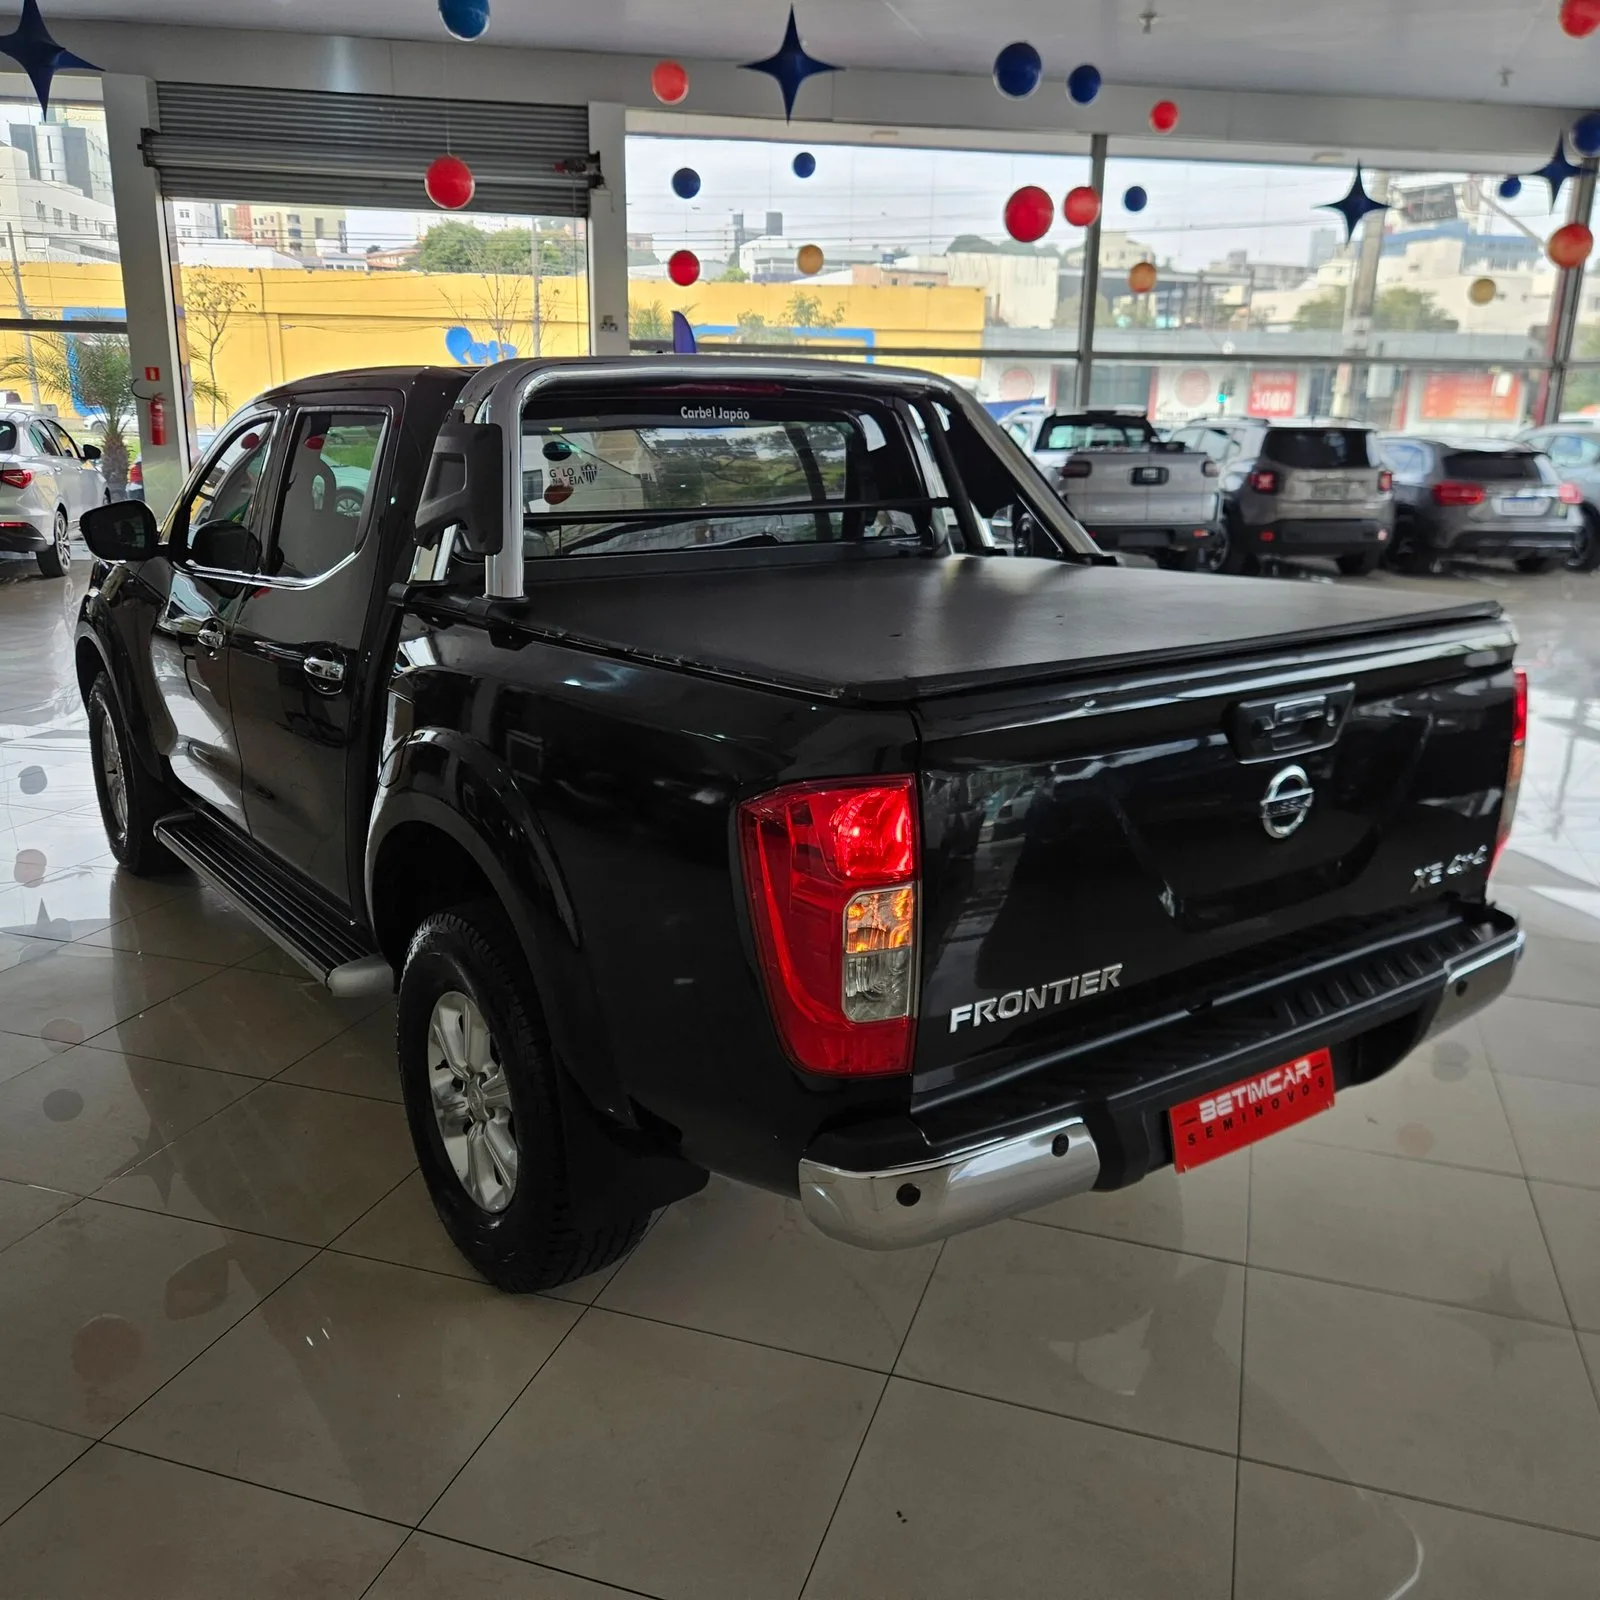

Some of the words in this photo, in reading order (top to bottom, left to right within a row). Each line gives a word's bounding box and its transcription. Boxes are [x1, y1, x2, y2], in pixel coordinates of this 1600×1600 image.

[680, 406, 716, 419] Carbel
[718, 407, 750, 422] Japão
[549, 467, 575, 478] GLO
[1410, 861, 1444, 893] XE
[949, 963, 1123, 1034] FRONTIER
[1187, 1076, 1325, 1146] SEMINOVOS
[1199, 1059, 1312, 1124] BETIMCAR
